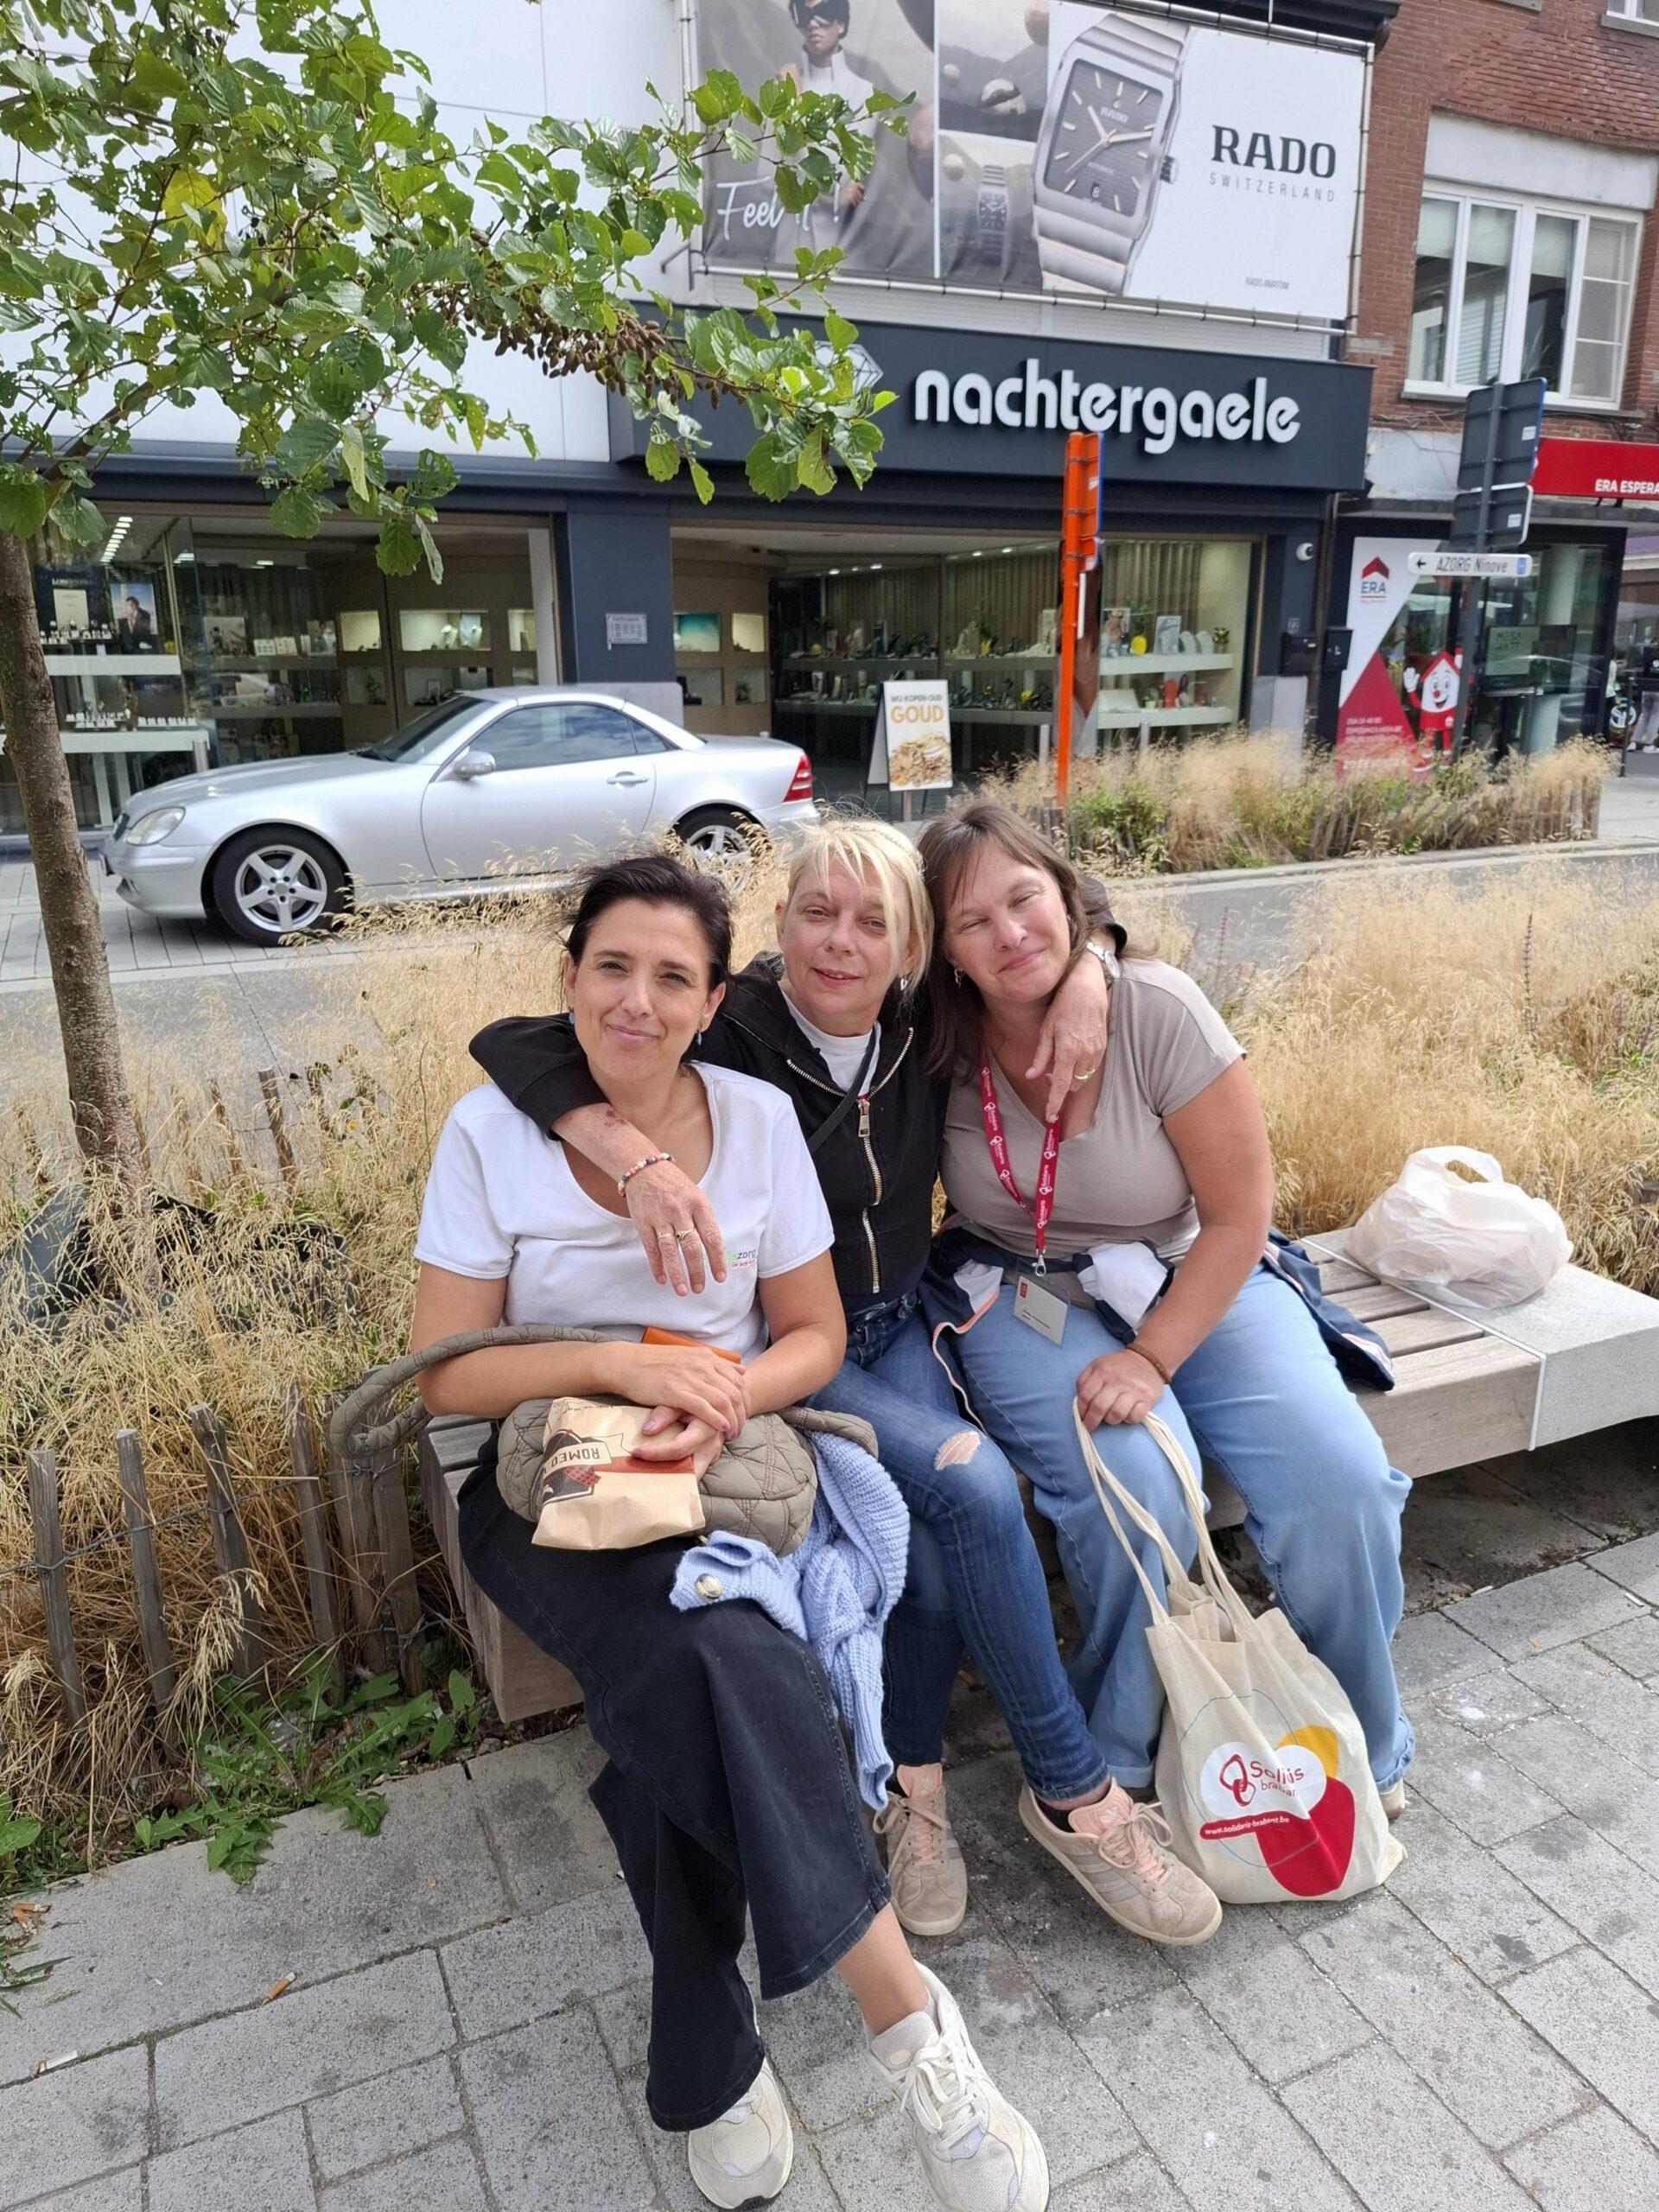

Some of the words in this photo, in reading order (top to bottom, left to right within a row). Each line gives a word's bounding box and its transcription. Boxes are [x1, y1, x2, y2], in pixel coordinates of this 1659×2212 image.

[1211, 124, 1336, 179] RADO
[1210, 172, 1335, 202] SWITZERLAND
[716, 176, 785, 241] Feel
[914, 358, 1301, 454] nachtergaele
[1595, 479, 1618, 493] ERA
[1620, 480, 1659, 494] ESPERA
[1435, 556, 1471, 572] AZORG
[1473, 557, 1508, 573] Ninove
[1361, 581, 1387, 594] ERA
[891, 704, 944, 724] GOUD
[550, 1447, 601, 1467] ROMEO
[1205, 1816, 1290, 1834] www.solidaris-brabant.be
